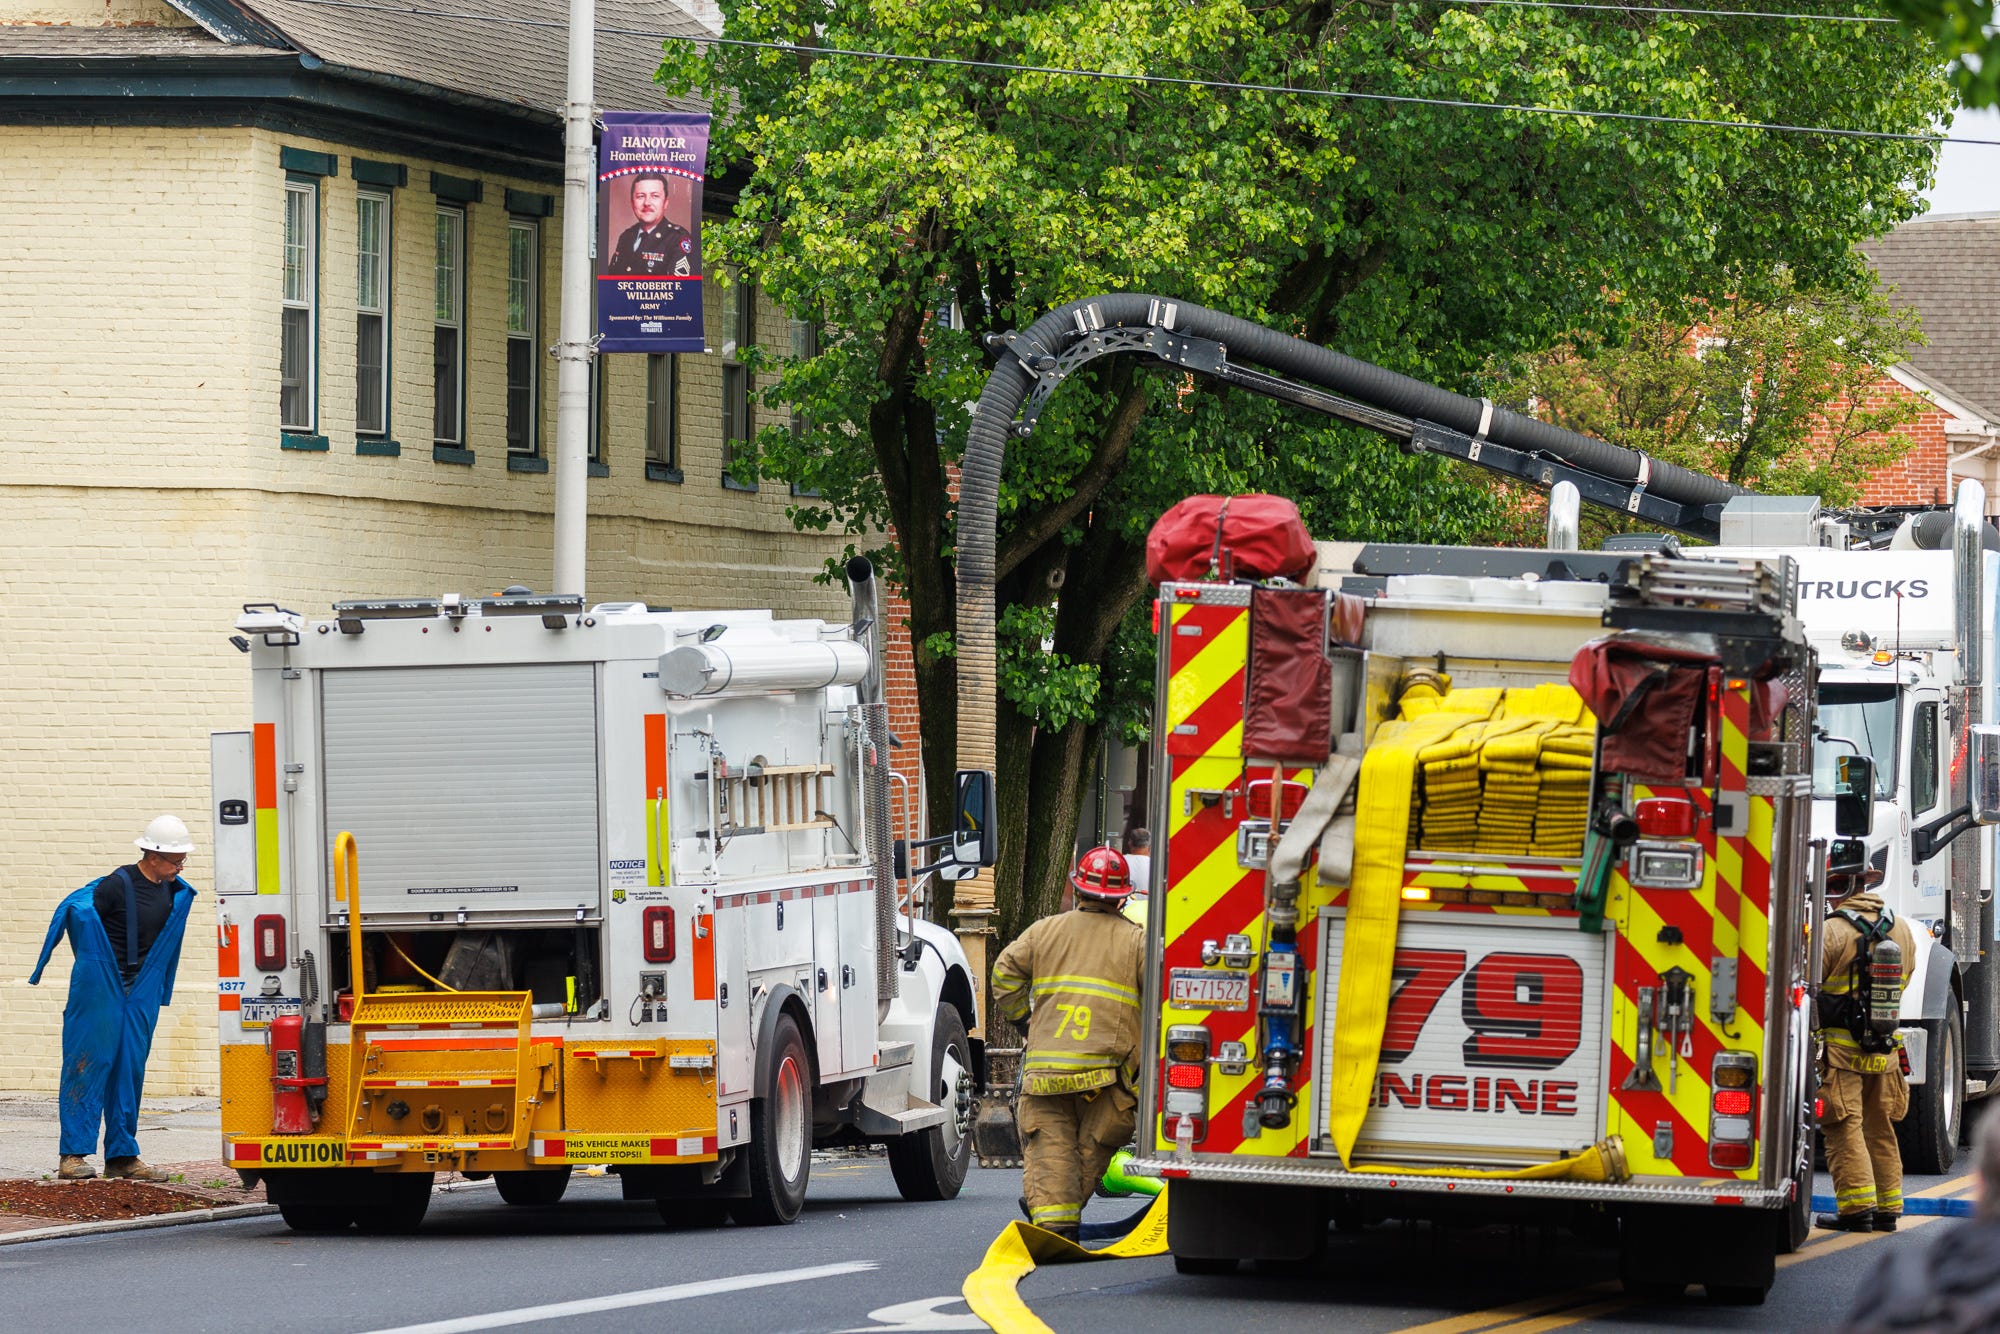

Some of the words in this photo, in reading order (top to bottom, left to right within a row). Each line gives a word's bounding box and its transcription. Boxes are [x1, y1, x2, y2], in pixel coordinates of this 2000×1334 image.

[621, 136, 686, 149] HANOVER
[609, 150, 668, 162] Hometown
[669, 151, 697, 162] Hero
[617, 281, 634, 291] SFC
[635, 281, 674, 291] ROBERT
[674, 281, 682, 291] F.
[626, 291, 674, 301] WILLIAMS
[1797, 579, 1929, 600] TRUCKS
[610, 860, 644, 869] NOTICE
[613, 890, 625, 899] 811
[218, 981, 246, 991] 1377
[1378, 946, 1584, 1071] 79
[1053, 1003, 1092, 1041] 79
[1850, 1054, 1887, 1072] TYLER
[1031, 1069, 1111, 1094] AMSPACHER
[1368, 1072, 1578, 1117] NGINE
[565, 1140, 584, 1148] THIS
[586, 1140, 619, 1148] VEHICLE
[620, 1140, 650, 1148] MAKES
[263, 1142, 344, 1163] CAUTION
[565, 1150, 608, 1159] FREQUENT
[610, 1150, 642, 1159] STOPS!!
